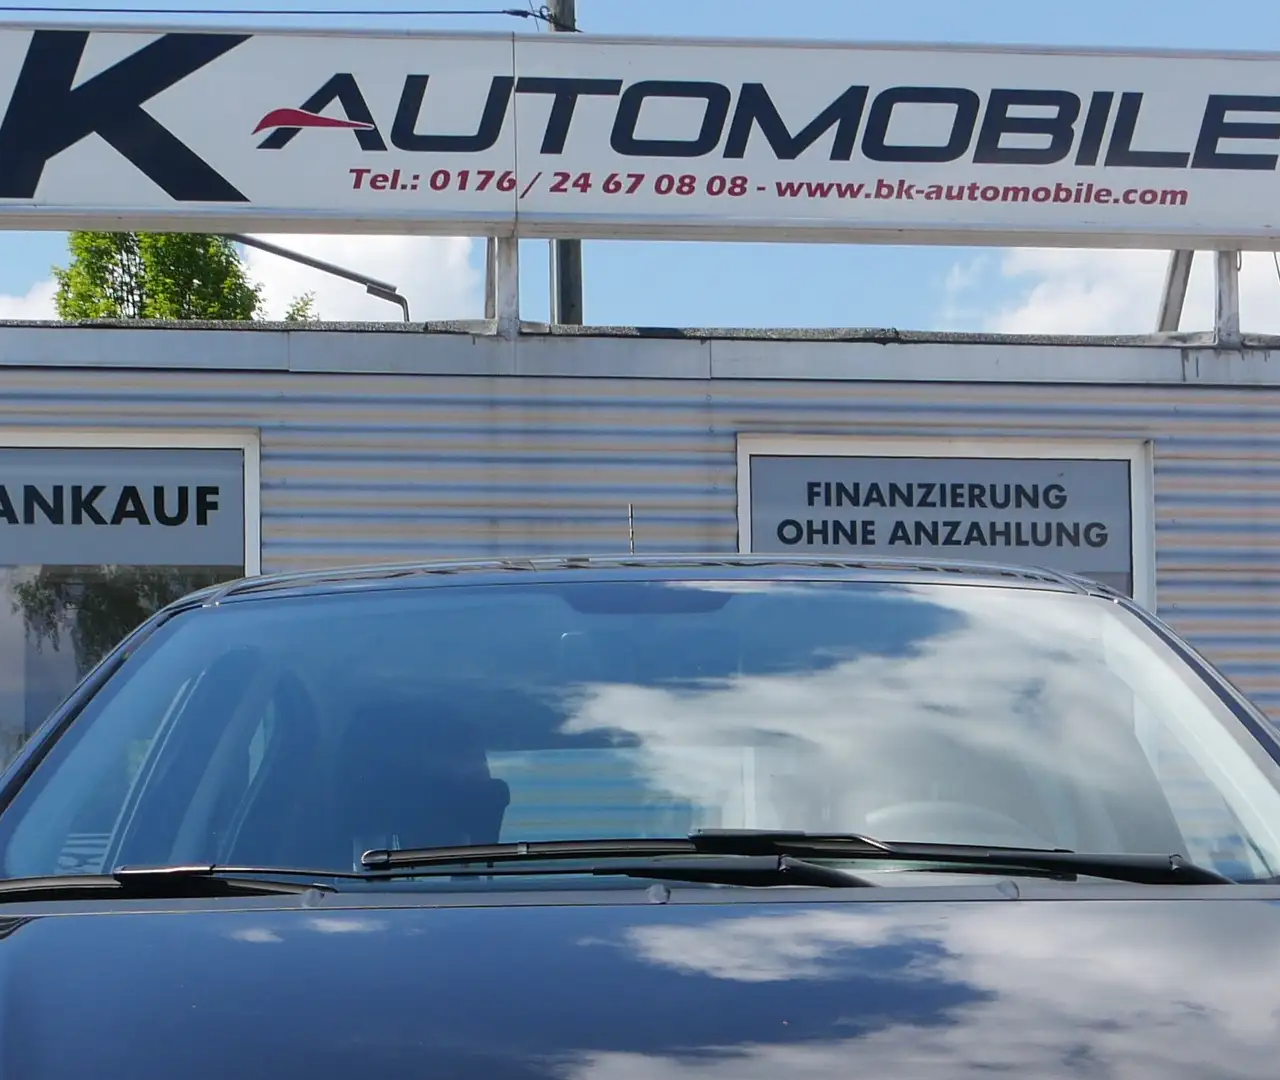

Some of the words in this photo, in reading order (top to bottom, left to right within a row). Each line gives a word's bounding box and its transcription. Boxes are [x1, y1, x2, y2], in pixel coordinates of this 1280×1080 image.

[350, 168, 419, 191] Tel.:
[430, 169, 517, 192] 0176
[549, 171, 592, 194] 24
[602, 172, 646, 195] 67
[654, 174, 697, 196] 08
[706, 175, 748, 197] 08
[775, 179, 1188, 206] www.bk-automobile.com
[806, 481, 1068, 510] FINANZIERUNG
[776, 518, 876, 546] OHNE
[887, 520, 1109, 548] ANZAHLUNG
